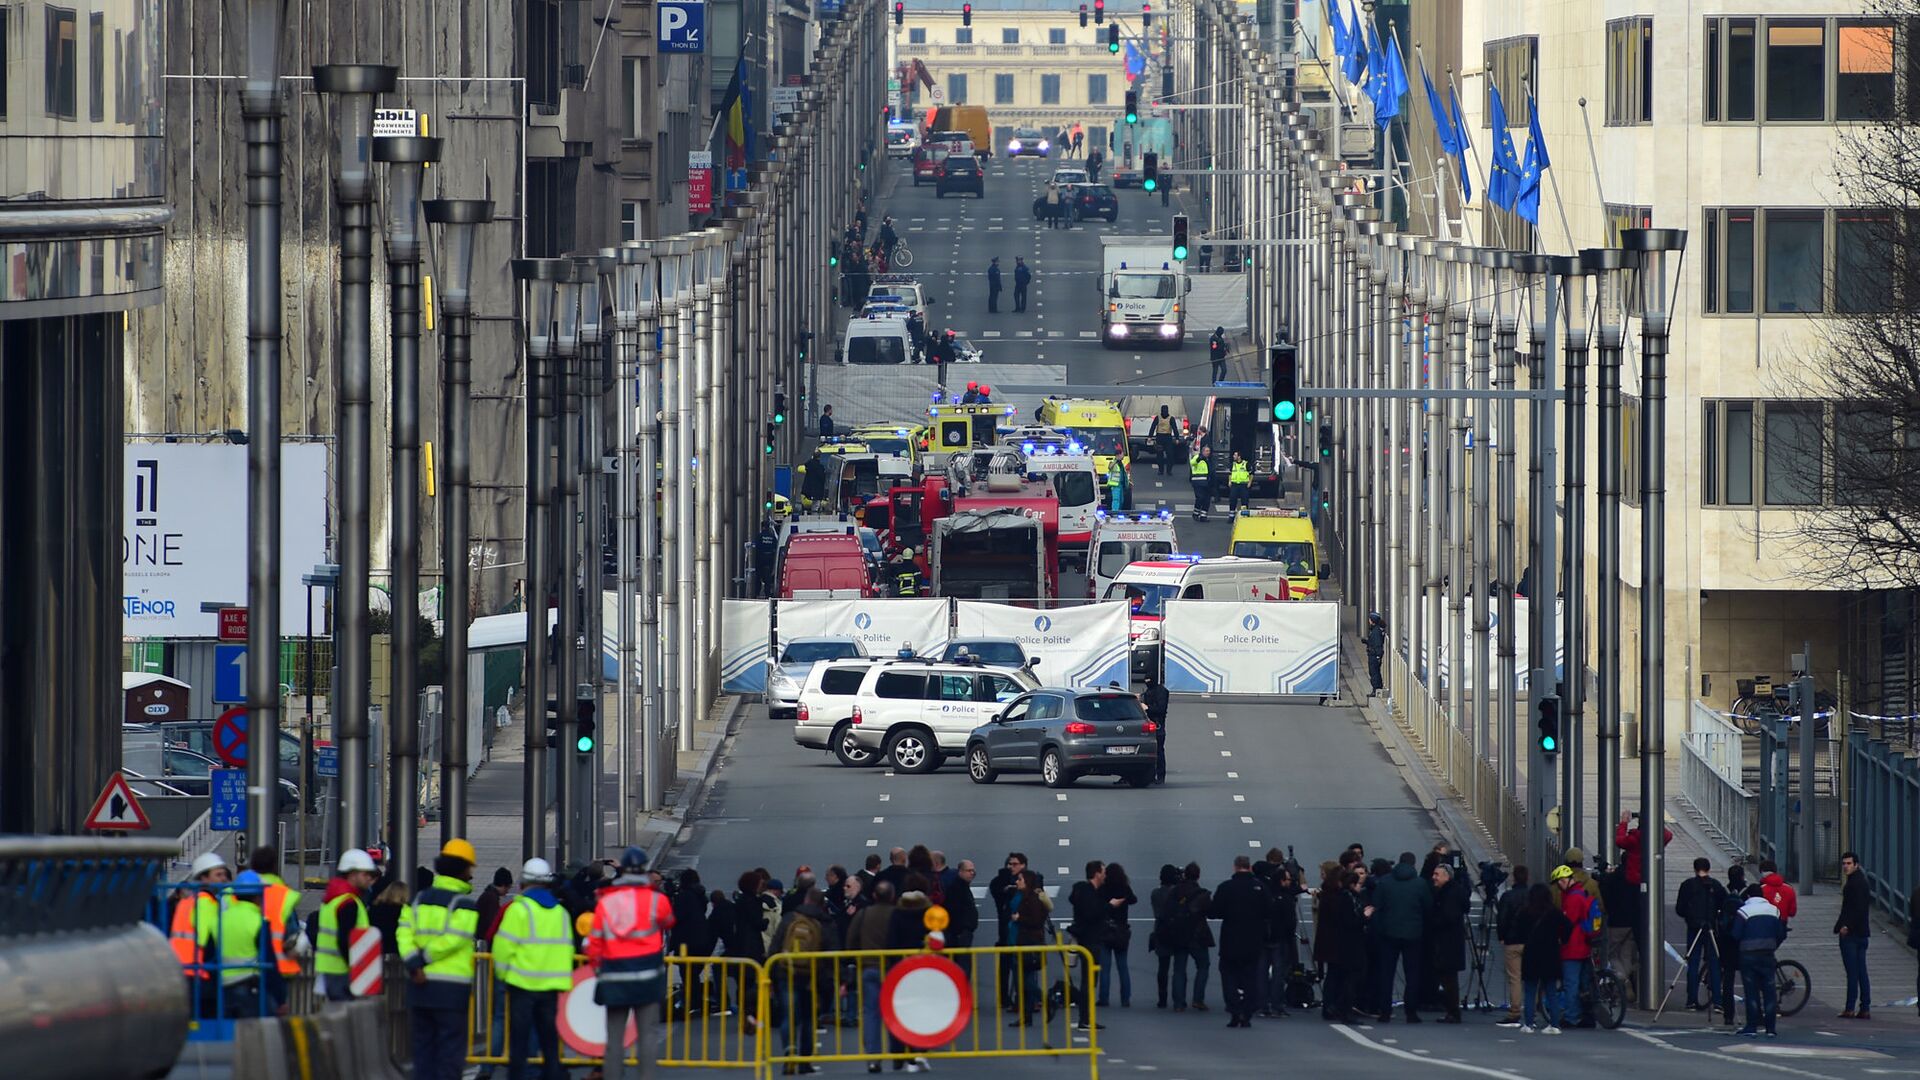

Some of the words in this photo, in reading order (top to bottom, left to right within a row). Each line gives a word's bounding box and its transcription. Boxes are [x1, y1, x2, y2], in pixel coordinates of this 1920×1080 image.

[661, 6, 688, 41] P
[1023, 508, 1046, 519] Car
[224, 614, 238, 622] AXE
[863, 633, 891, 642] Politie
[1043, 635, 1071, 644] Politie
[1223, 635, 1249, 643] Police
[1251, 635, 1279, 644] Politie
[951, 705, 976, 713] Police
[230, 803, 238, 813] 7
[228, 816, 240, 826] 16
